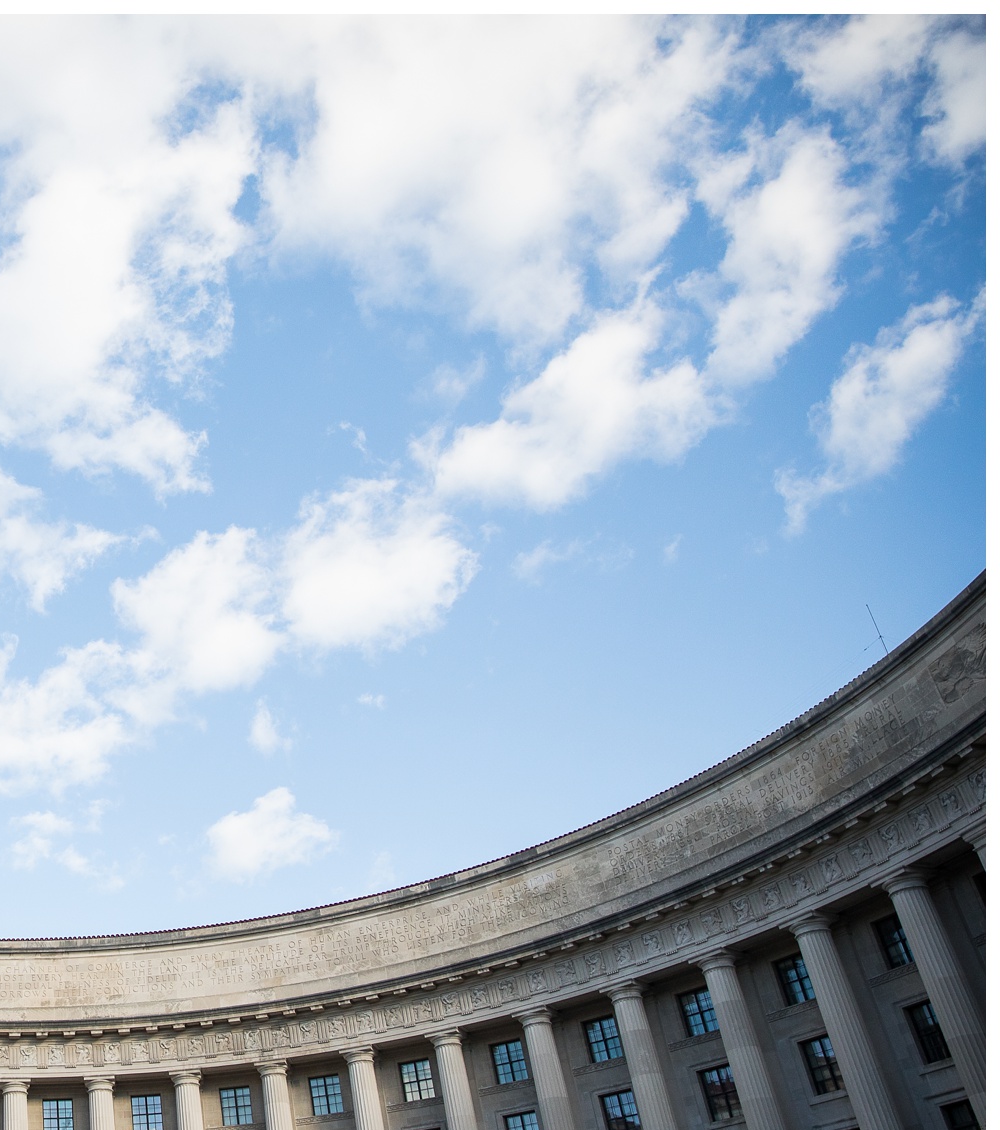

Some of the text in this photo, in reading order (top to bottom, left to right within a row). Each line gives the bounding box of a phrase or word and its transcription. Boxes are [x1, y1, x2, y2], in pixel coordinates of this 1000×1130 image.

[608, 835, 649, 855] POSTAL
[656, 814, 695, 836] MONEY
[705, 785, 750, 814] ORDERS
[757, 768, 782, 786] 1864
[795, 728, 847, 764] FOREIGN
[854, 696, 894, 728] MONEY
[759, 760, 814, 797] DELIVERY
[765, 772, 814, 805] SAVINGS
[5, 965, 58, 973] CHANNEL
[66, 964, 79, 972] OF
[88, 960, 151, 971] COMMERCE
[160, 957, 182, 966] AND
[190, 952, 222, 962] EVERY
[230, 944, 280, 957] THEATRE
[288, 940, 301, 948] OF
[310, 930, 350, 944] HUMAN
[436, 903, 458, 915] AND
[18, 982, 51, 990] EQUAL
[116, 978, 128, 986] OF
[137, 973, 181, 984] FIDELITY
[225, 966, 242, 975] THE
[251, 957, 300, 971] DELICATE
[308, 952, 327, 962] EAR
[334, 943, 368, 957] TRUMP
[376, 929, 430, 948] THROUGH
[436, 916, 474, 933] WHICH
[31, 973, 62, 981] EVERY
[132, 968, 151, 977] THE
[160, 965, 187, 974] LAND
[196, 962, 206, 970] IN
[215, 958, 236, 968] THE
[244, 948, 303, 964] AMPLITUDE
[312, 944, 324, 952] OF
[332, 939, 348, 948] ITS
[441, 914, 449, 922] IT
[54, 989, 88, 997] THEIR
[182, 980, 202, 989] AND
[211, 974, 242, 985] THEIR
[250, 962, 317, 980] SYMPATHIES
[328, 958, 340, 967] TO
[348, 953, 366, 963] ALL
[371, 945, 398, 958] WHO
[406, 934, 444, 950] LISTEN
[452, 926, 473, 938] FOR
